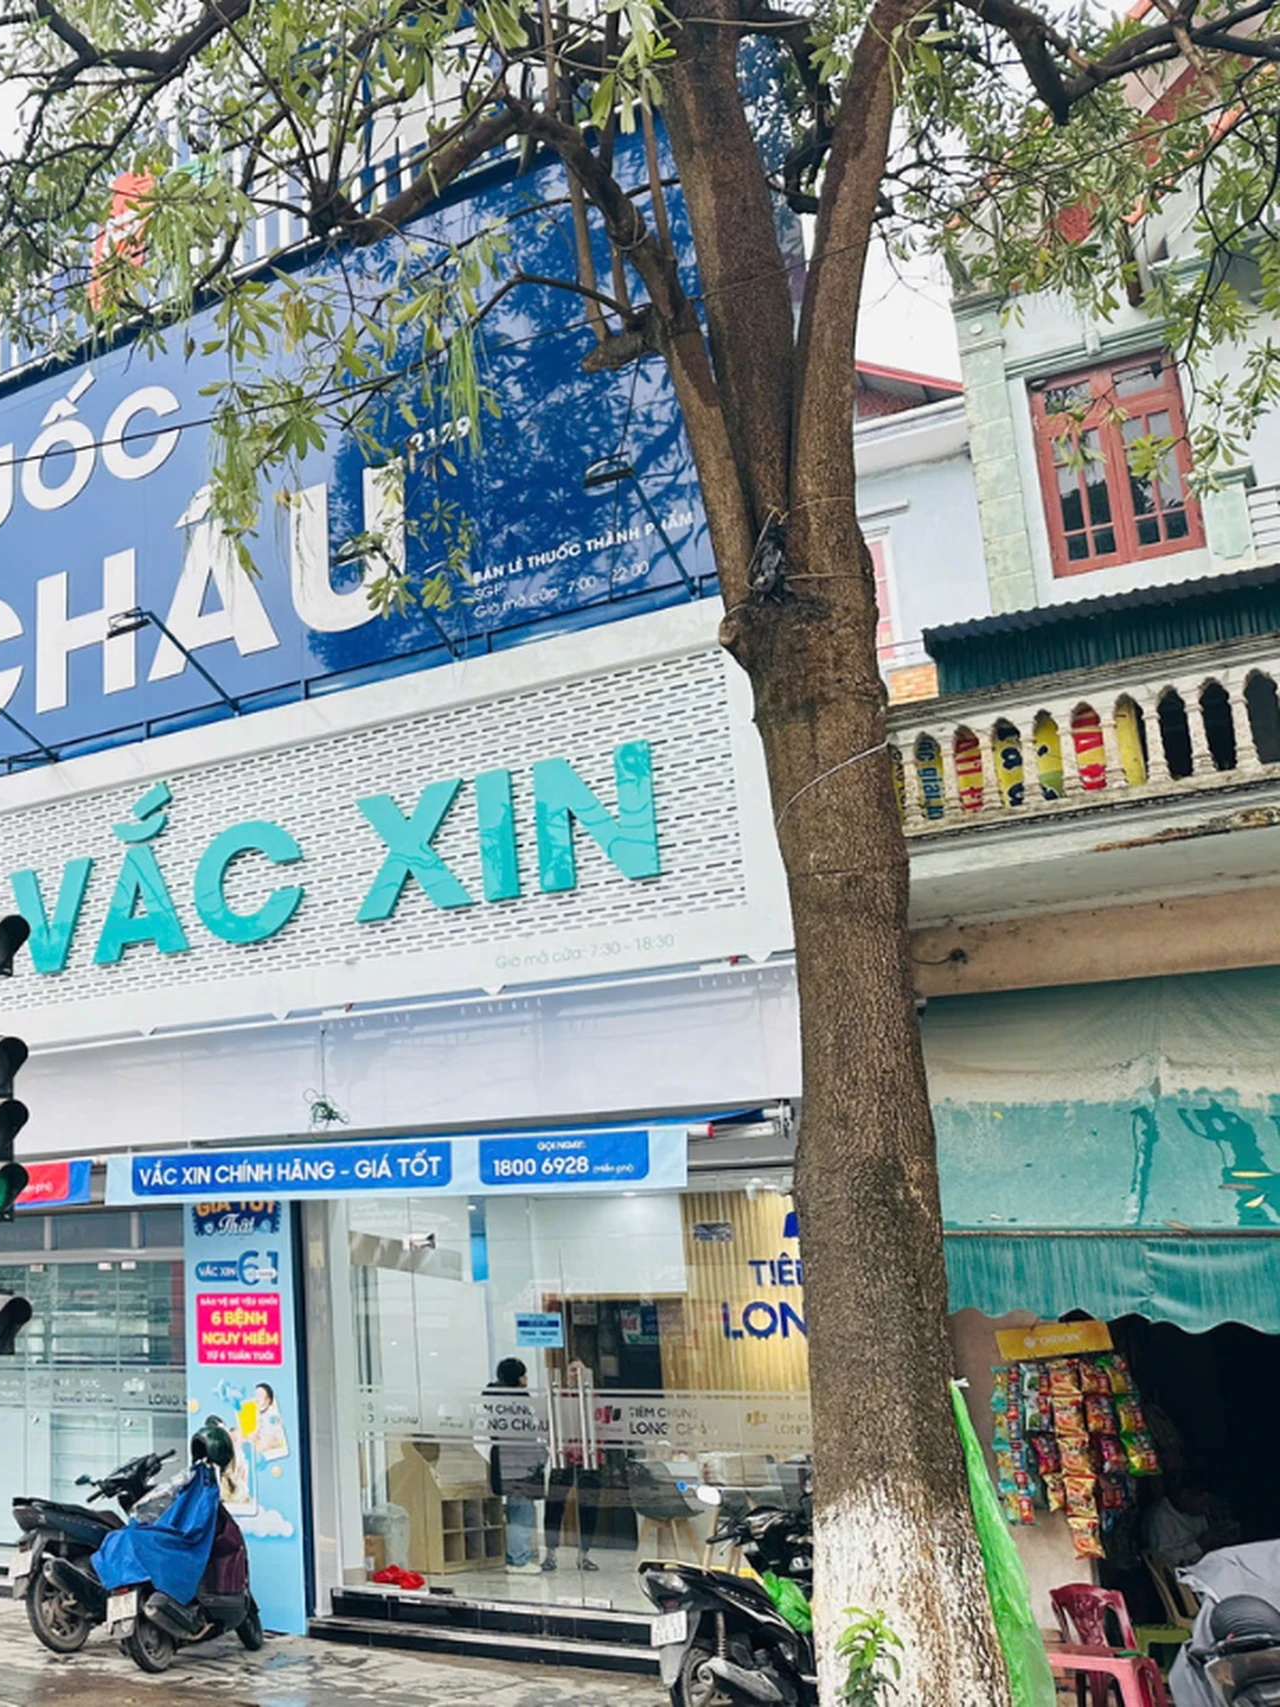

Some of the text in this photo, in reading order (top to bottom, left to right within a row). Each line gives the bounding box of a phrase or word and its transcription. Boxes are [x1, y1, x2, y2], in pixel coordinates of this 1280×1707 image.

[526, 539, 582, 569] THUỐC
[585, 526, 641, 553] THÀNH
[567, 575, 597, 594] 7:00
[10, 782, 305, 975] VẮC
[354, 739, 662, 923] XIN
[590, 940, 621, 957] 7:30
[634, 934, 675, 951] 18:30
[139, 1158, 179, 1187] VẮC
[181, 1164, 213, 1186] XIN
[215, 1157, 273, 1184] CHÍNH
[354, 1153, 391, 1180] GIÁ
[397, 1149, 442, 1178] TỐT
[493, 1158, 537, 1177] 1800
[541, 1156, 590, 1174] 6928
[199, 1263, 218, 1277] VẮC
[220, 1265, 236, 1276] XIN
[211, 1306, 268, 1329] 6 BỆNH
[721, 1301, 808, 1340] LON
[202, 1331, 241, 1345] NGUY
[629, 1421, 669, 1435] LONG
